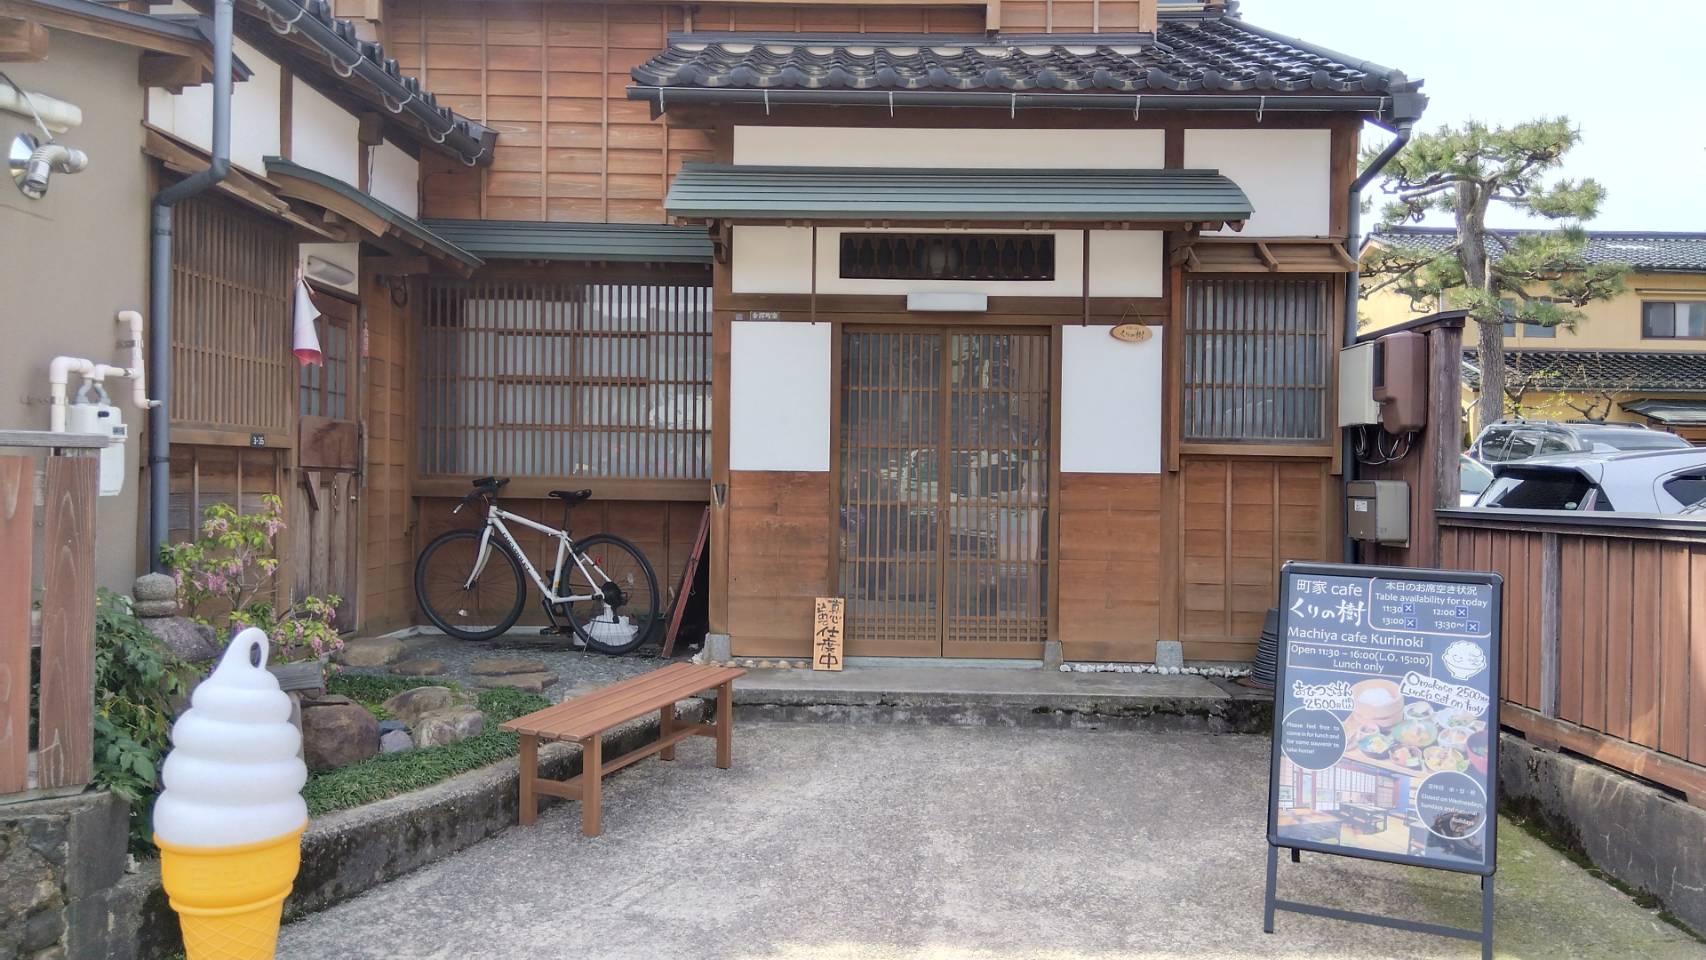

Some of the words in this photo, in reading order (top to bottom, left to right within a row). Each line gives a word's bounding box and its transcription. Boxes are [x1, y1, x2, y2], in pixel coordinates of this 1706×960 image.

[1296, 579, 1327, 594] 町家
[1331, 583, 1363, 597] cafe
[1385, 582, 1477, 595] 本日のお席空き状況
[1375, 592, 1398, 601] Table
[1399, 593, 1447, 606] availability
[1447, 596, 1460, 605] for
[1461, 598, 1488, 608] today
[1290, 597, 1367, 627] くりの樹
[1382, 605, 1403, 613] 11:30
[1433, 608, 1455, 616] 12:00
[1382, 617, 1404, 625] 13:00
[1287, 627, 1338, 643] Machiya
[1341, 631, 1368, 643] cafe
[1371, 634, 1424, 648] Kurinoki
[1291, 644, 1316, 655] Open
[1318, 648, 1340, 658] 11:30
[1401, 655, 1430, 667] 15:00)
[1333, 660, 1361, 670] Lunch
[1363, 662, 1385, 673] only
[1407, 672, 1453, 692] Omakase
[1400, 682, 1433, 700] Lunch
[1451, 700, 1464, 709] on
